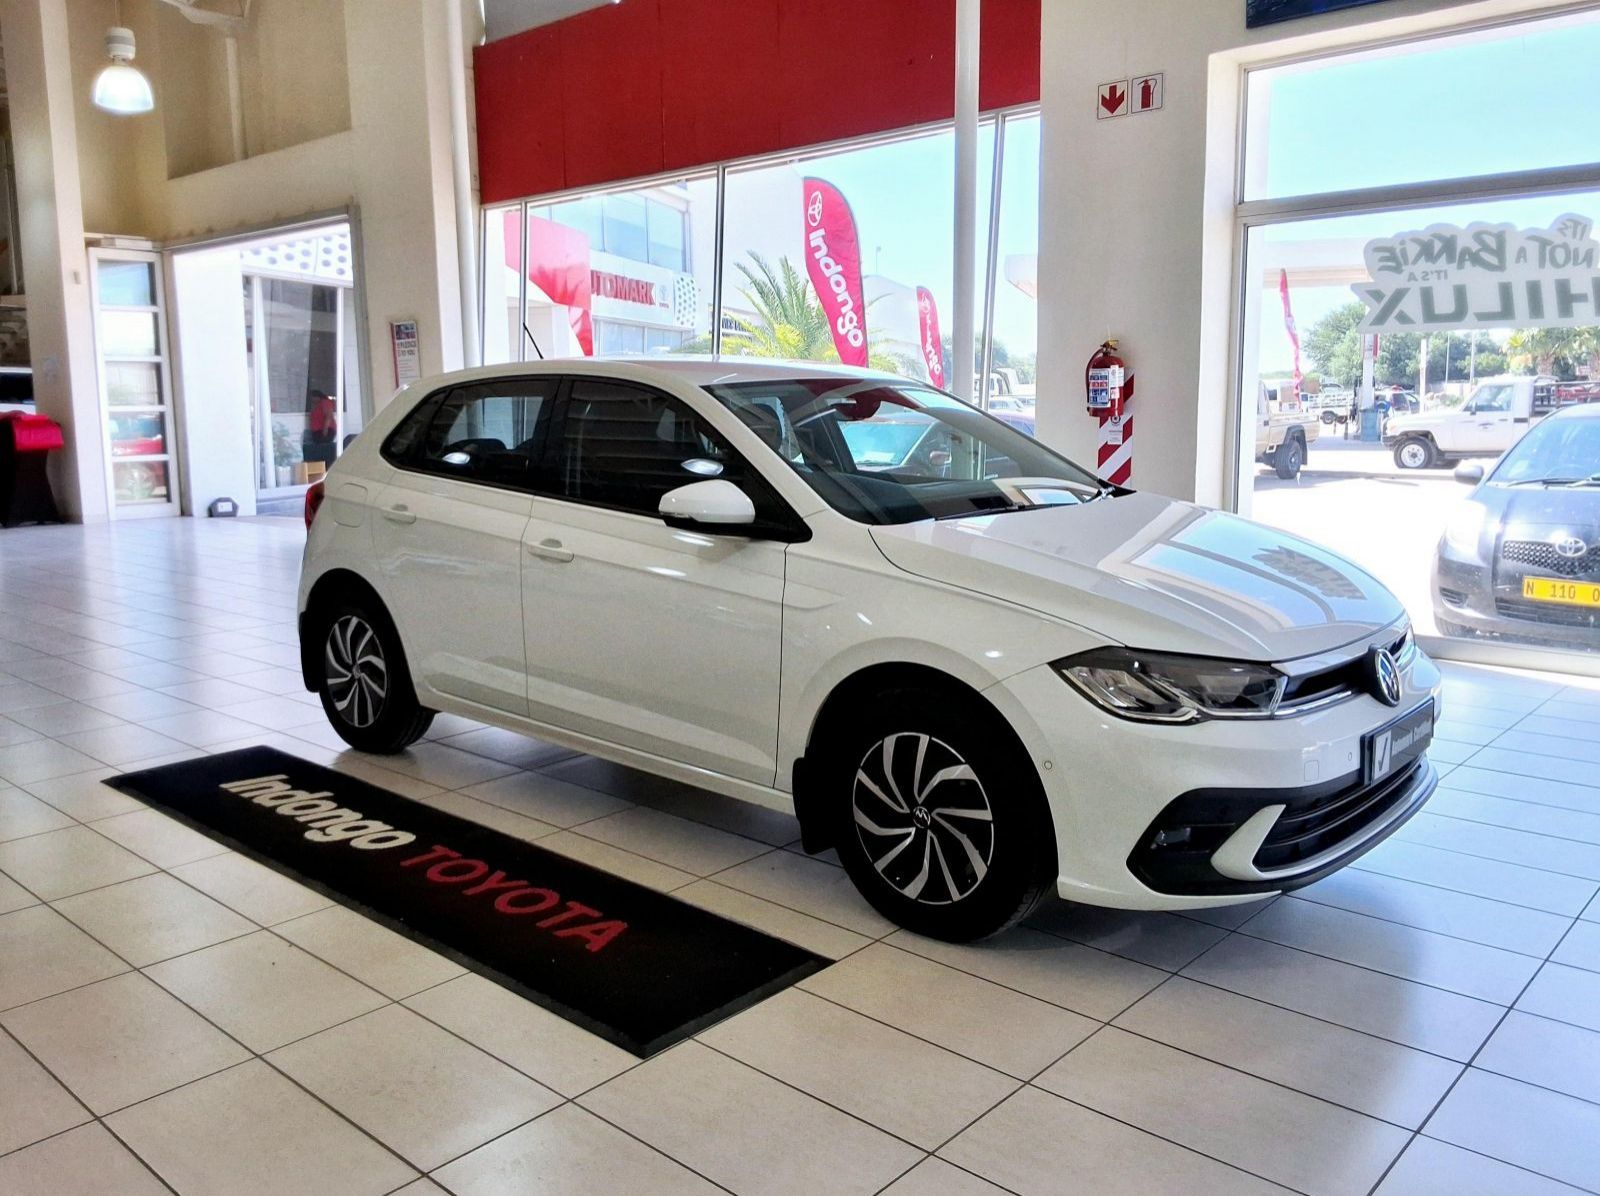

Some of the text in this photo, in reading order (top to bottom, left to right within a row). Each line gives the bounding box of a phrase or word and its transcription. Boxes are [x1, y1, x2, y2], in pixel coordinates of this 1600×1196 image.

[809, 229, 864, 347] Indongo
[1526, 581, 1534, 595] N
[1550, 583, 1576, 599] 110
[219, 774, 628, 952] Indongo TOYOTA
